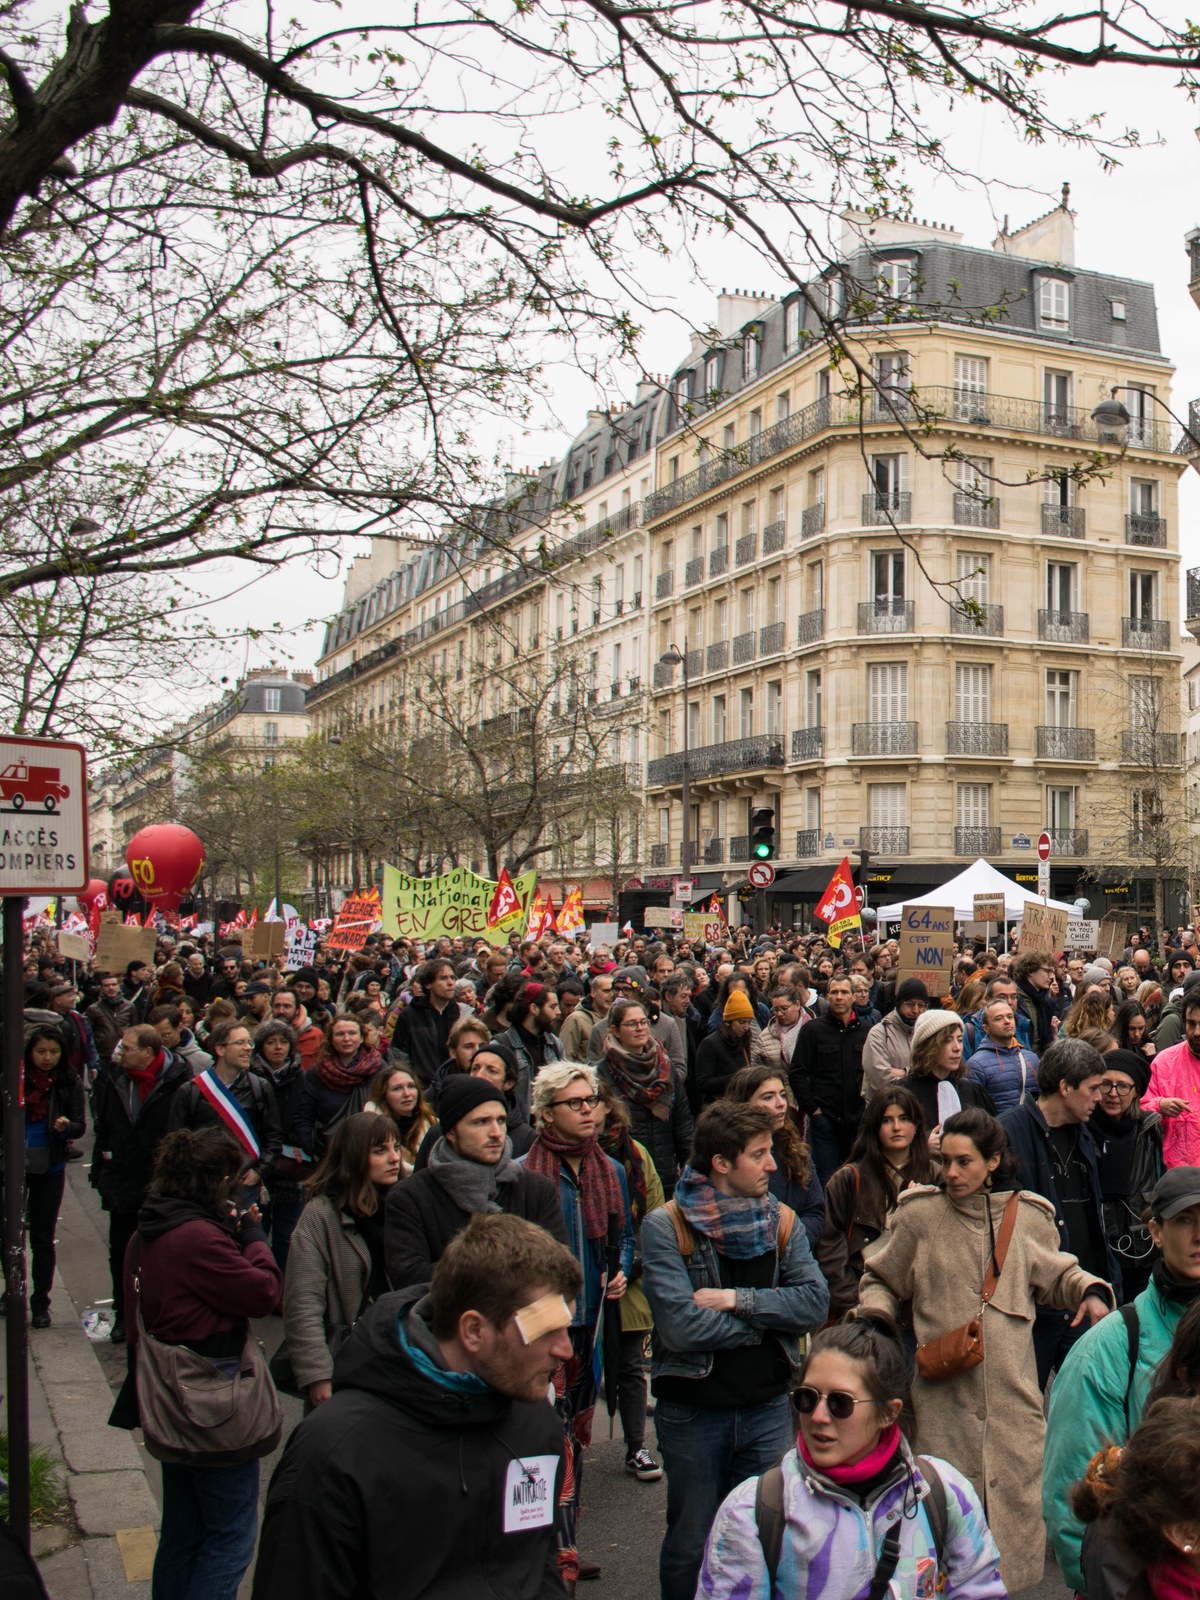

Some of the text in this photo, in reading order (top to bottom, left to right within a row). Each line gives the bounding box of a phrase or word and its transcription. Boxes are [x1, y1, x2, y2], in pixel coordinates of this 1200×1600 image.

[2, 827, 58, 848] ACCÈS
[0, 853, 76, 870] OMPIERS
[132, 859, 155, 884] FO
[112, 879, 133, 899] FO
[396, 910, 430, 934] EN
[442, 905, 514, 934] GRÈ
[908, 909, 950, 931] 64 ANS
[704, 923, 720, 941] 68
[909, 935, 931, 944] C'EST
[916, 947, 944, 967] NON
